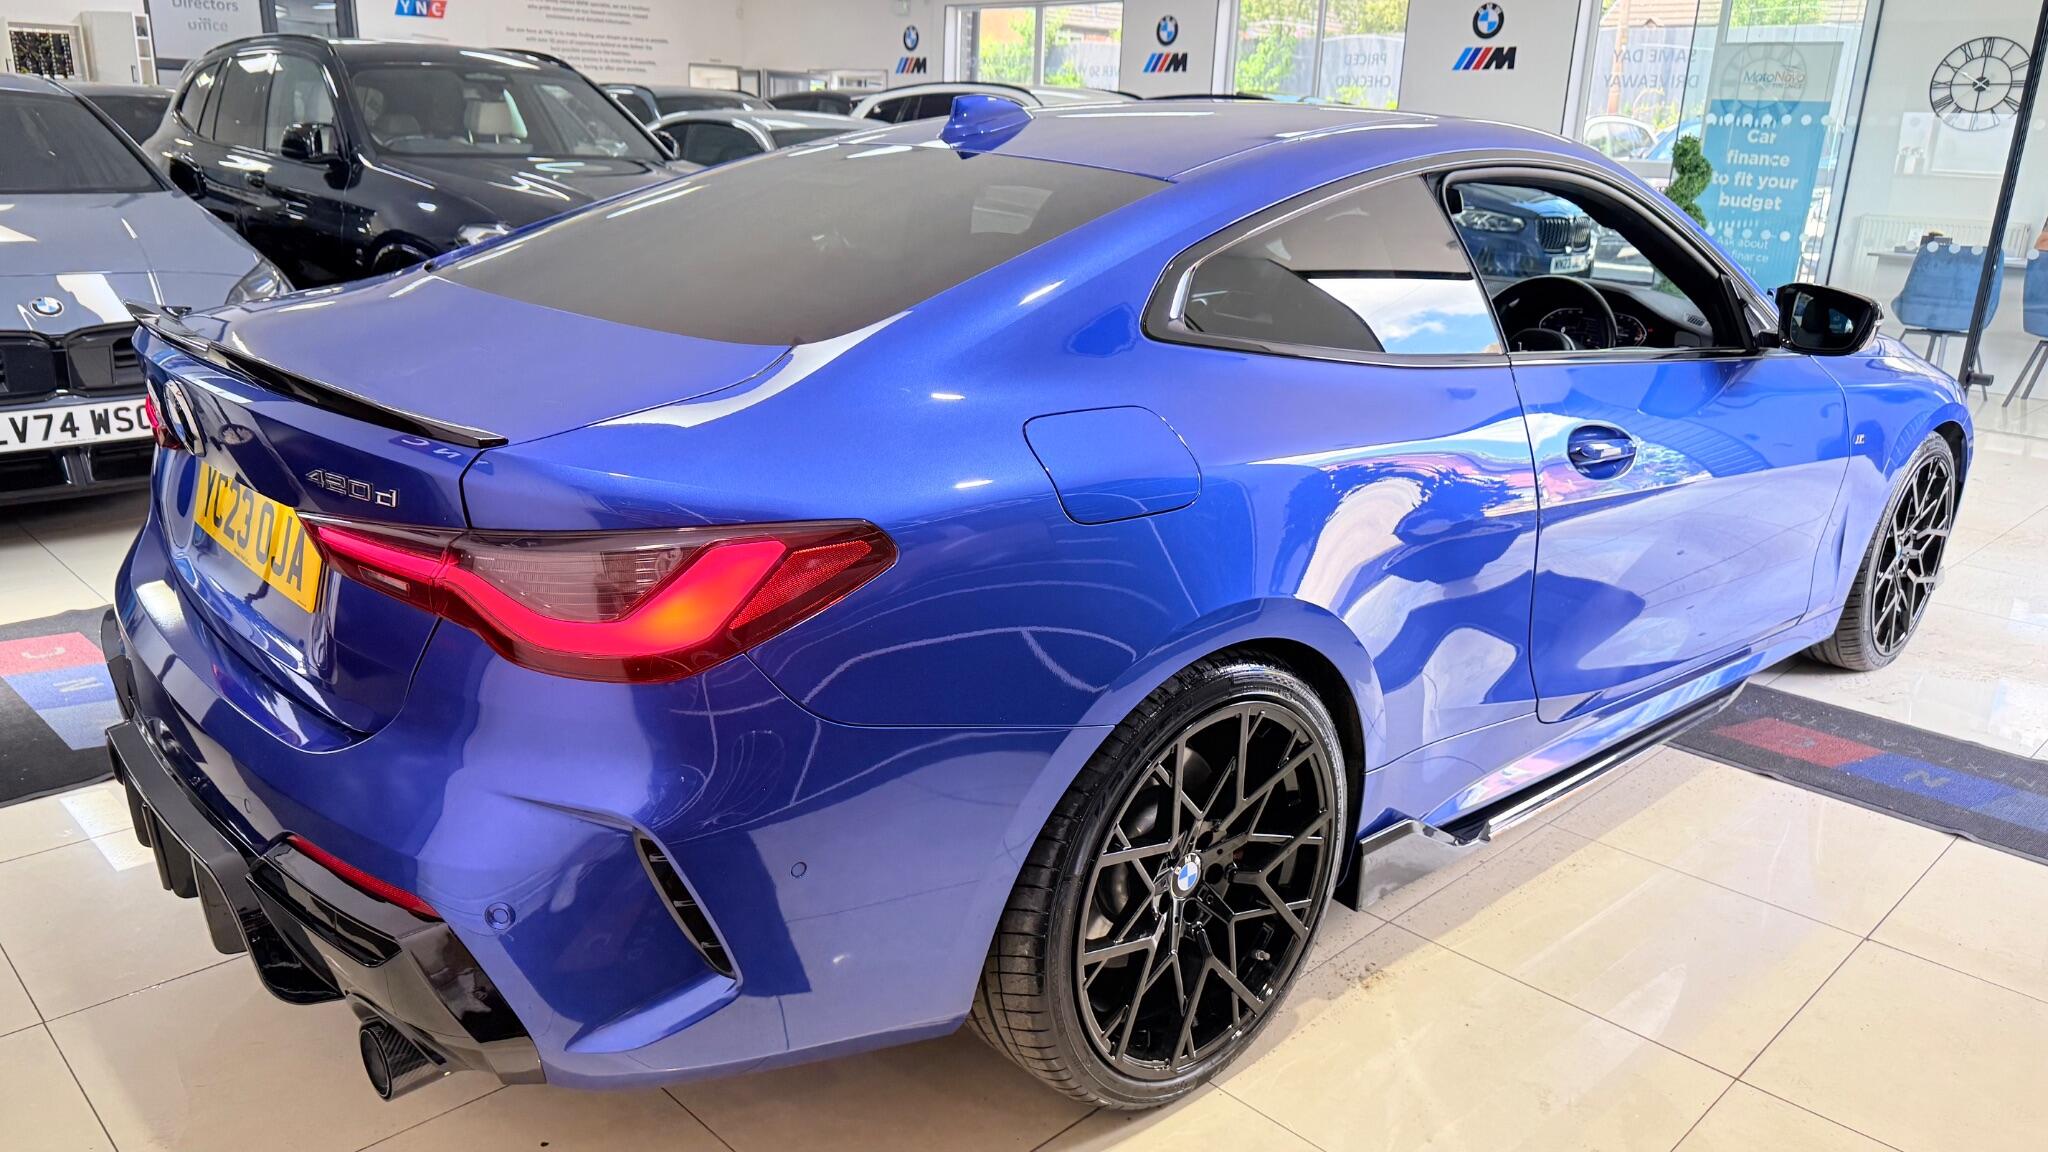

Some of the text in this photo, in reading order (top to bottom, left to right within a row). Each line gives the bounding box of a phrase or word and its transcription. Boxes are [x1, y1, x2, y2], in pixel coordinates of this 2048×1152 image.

[400, 0, 443, 16] YNC
[1747, 129, 1776, 144] Car
[1727, 149, 1790, 167] finance
[1711, 170, 1798, 191] to fit your
[1719, 191, 1782, 212] budget
[0, 411, 80, 446] V74
[305, 468, 399, 508] 420d
[204, 466, 306, 593] YC23 OJA
